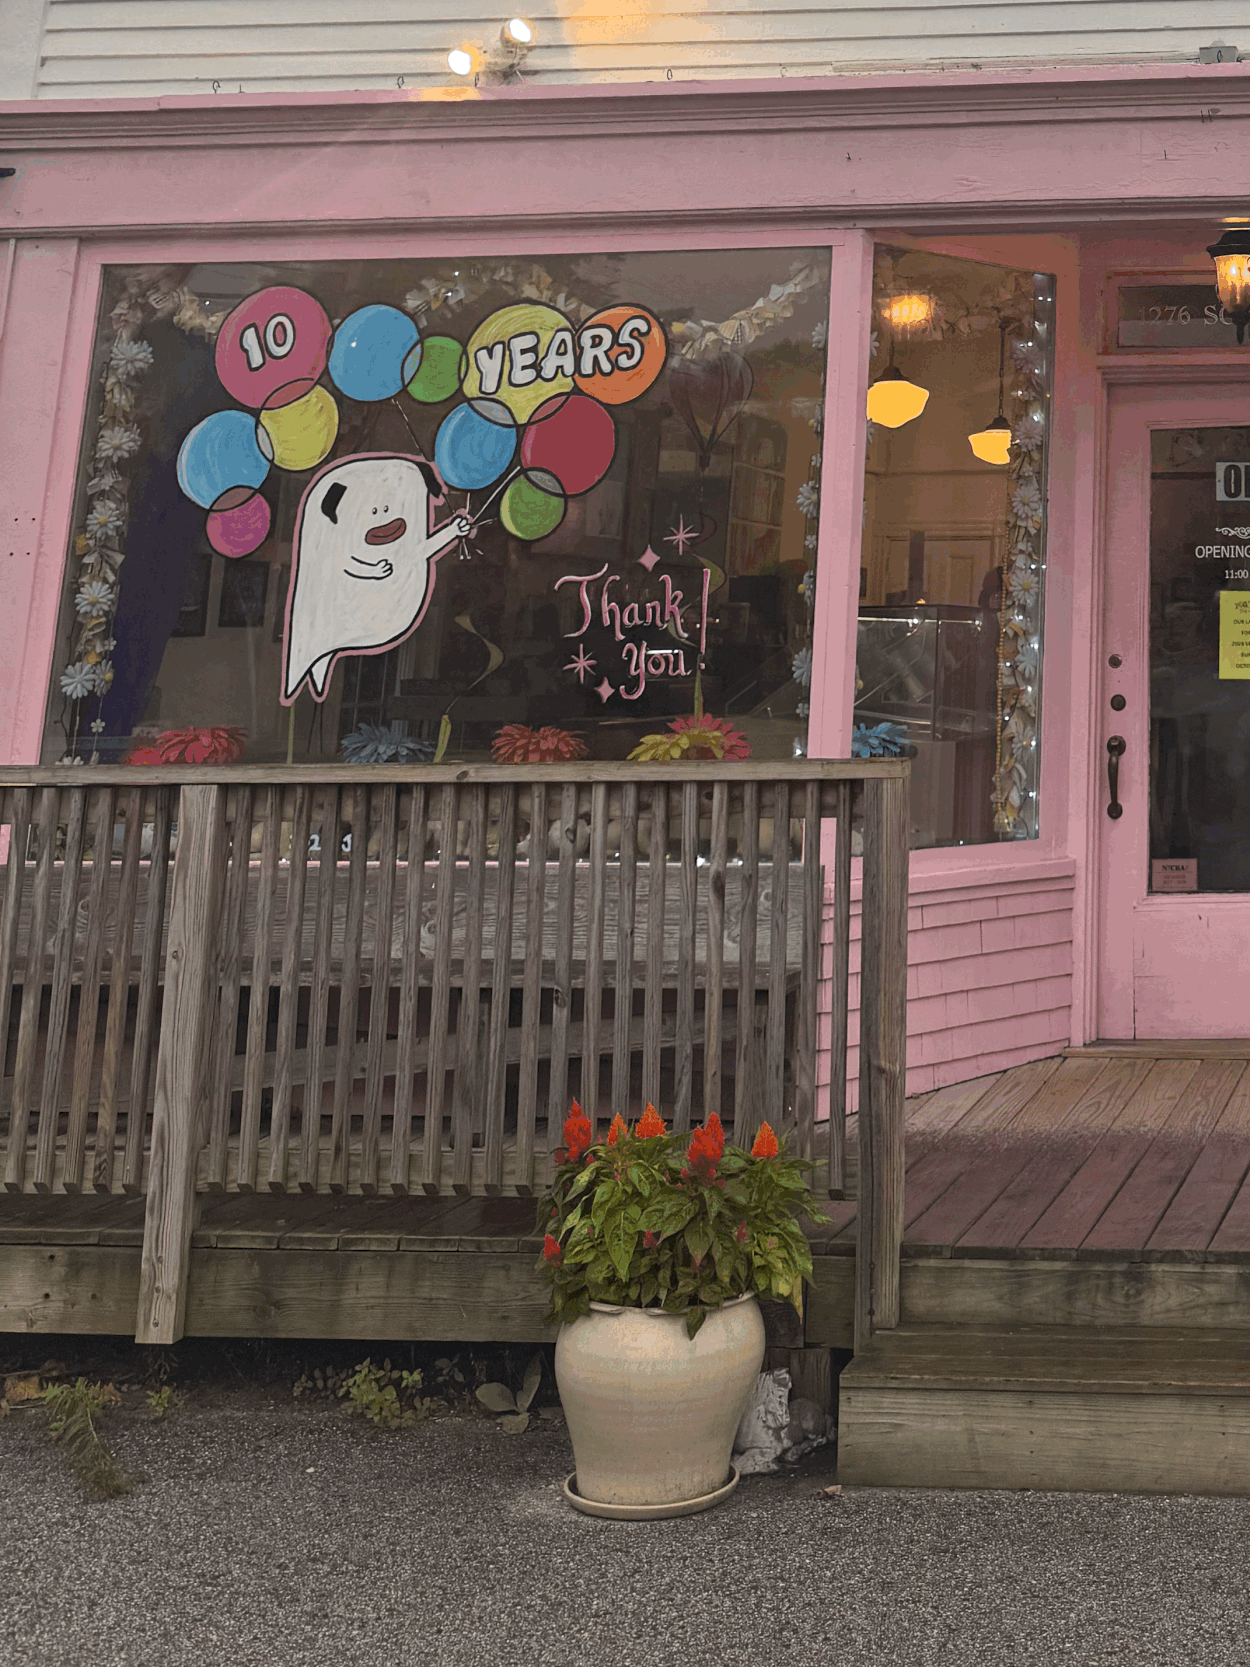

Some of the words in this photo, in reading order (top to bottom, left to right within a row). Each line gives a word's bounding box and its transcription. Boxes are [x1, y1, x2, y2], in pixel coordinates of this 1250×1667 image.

[1138, 305, 1191, 325] 1276
[240, 314, 296, 372] 10
[475, 314, 651, 395] YEARS
[1224, 569, 1249, 579] 11:00
[554, 563, 688, 641] Thank
